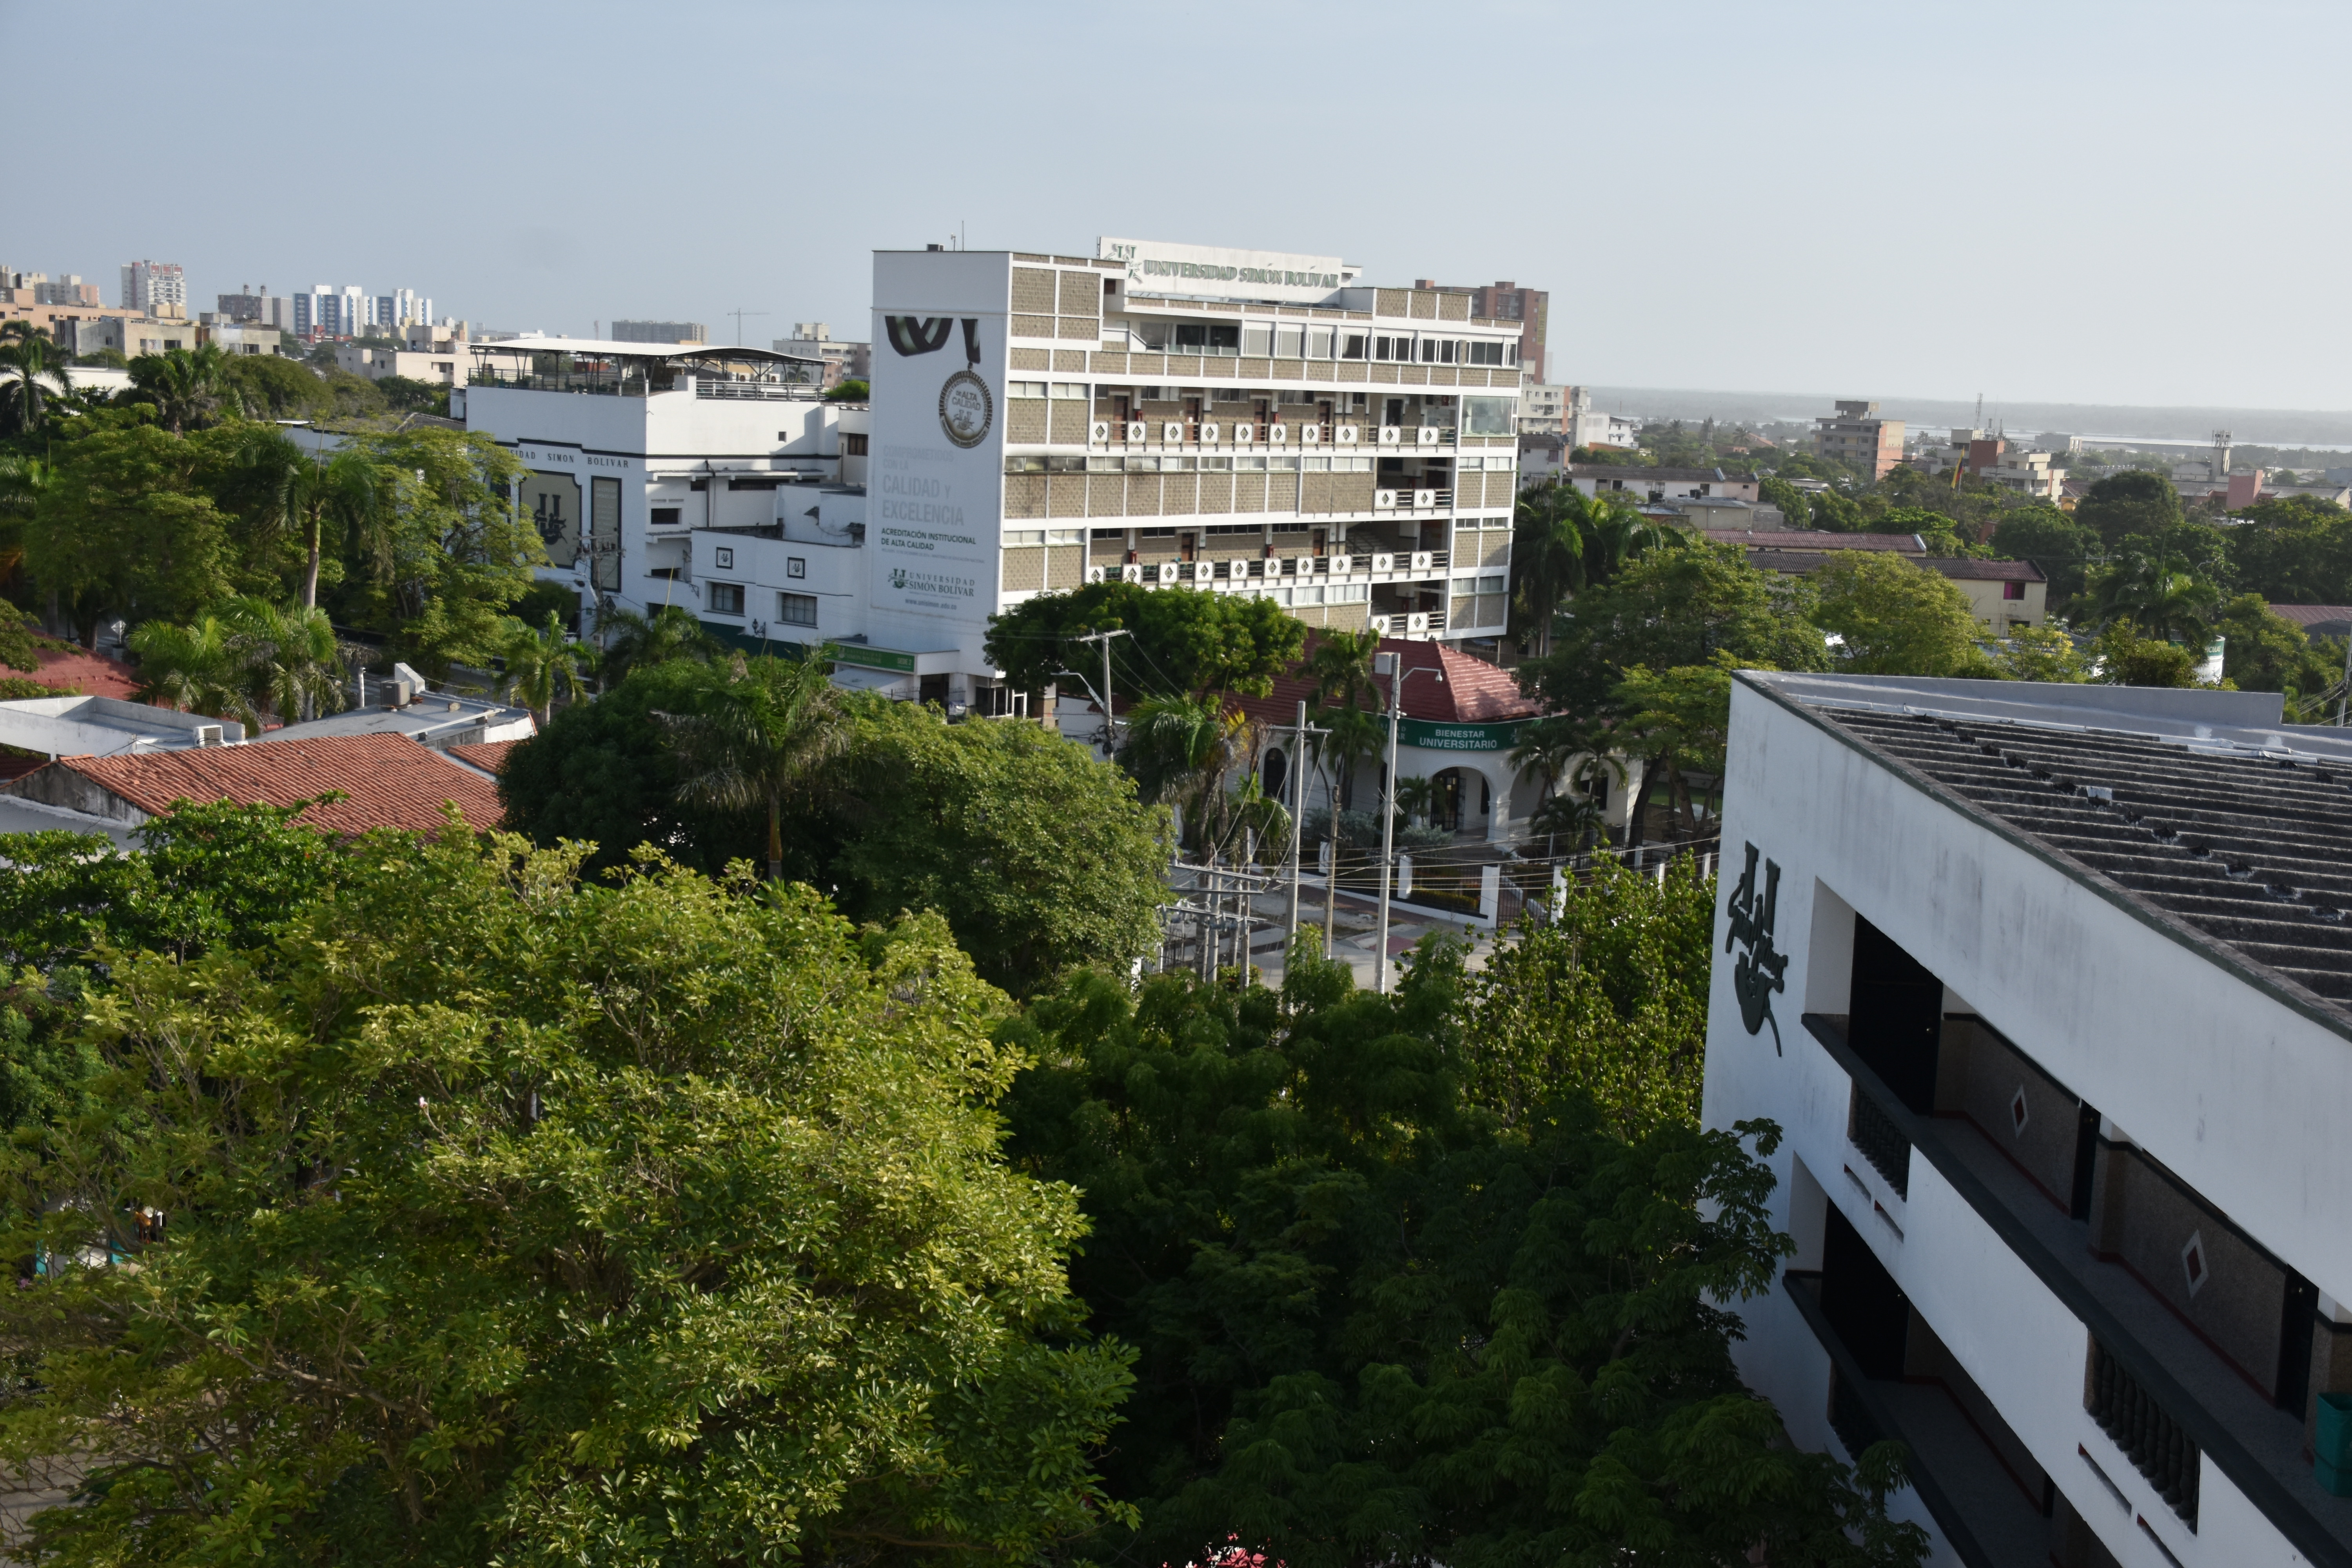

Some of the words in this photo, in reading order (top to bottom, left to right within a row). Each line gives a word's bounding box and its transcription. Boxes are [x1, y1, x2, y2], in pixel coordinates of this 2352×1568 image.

[1144, 259, 1237, 281] UNIVERSIDAD
[962, 391, 977, 402] ALTA
[952, 397, 980, 411] CALIDAD
[547, 453, 574, 463] SIMON
[588, 457, 629, 468] BOLIVAR
[884, 446, 954, 462] COMPROMETIDOS
[883, 458, 897, 470] CON
[900, 460, 909, 470] LA
[883, 474, 940, 498] CALIDAD
[945, 485, 951, 499] Y
[882, 499, 964, 526] EXCELENCIA
[882, 528, 927, 539] ACREDITACIÓN
[928, 533, 976, 544] INSTITUCIONAL
[907, 541, 934, 550] CALIDAD
[909, 572, 975, 586] UNIVERSIDAD
[909, 581, 936, 592] SIMÓN
[938, 584, 974, 597] BOLÍVAR
[1435, 729, 1485, 738] BIENESTAR
[1419, 737, 1497, 749] UNIVERSITARIO
